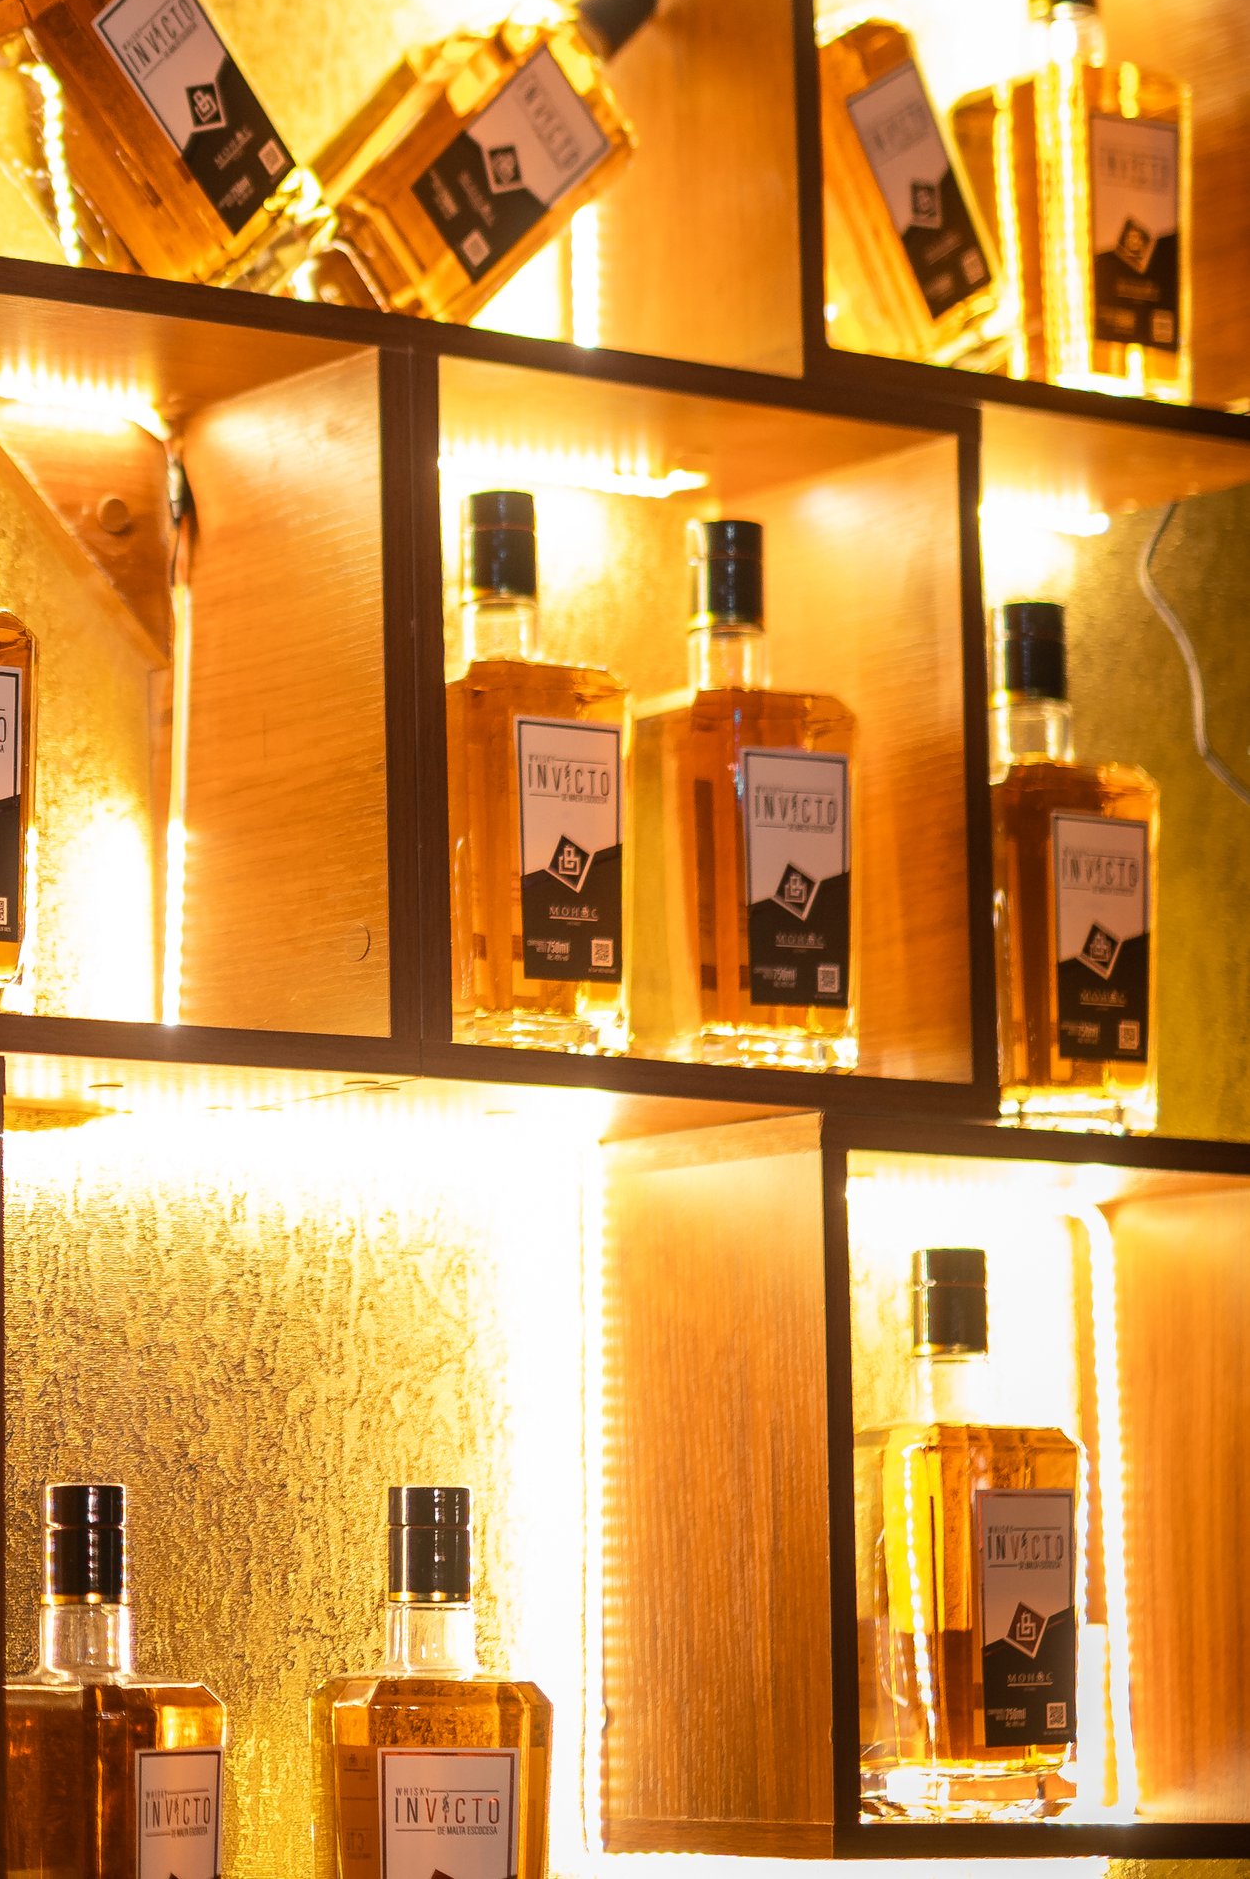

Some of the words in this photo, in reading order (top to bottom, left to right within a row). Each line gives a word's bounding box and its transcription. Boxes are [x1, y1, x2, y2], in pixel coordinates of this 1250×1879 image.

[528, 763, 610, 796] INVICTO
[754, 792, 837, 826] INVICTO
[987, 1532, 1065, 1561] INVICTO
[395, 1787, 430, 1796] WHISKY
[145, 1796, 211, 1829] INVICTO
[395, 1793, 500, 1824] INVICTO
[437, 1826, 445, 1835] DE
[447, 1826, 466, 1835] MALTA
[467, 1826, 498, 1836] ESCOCESA
